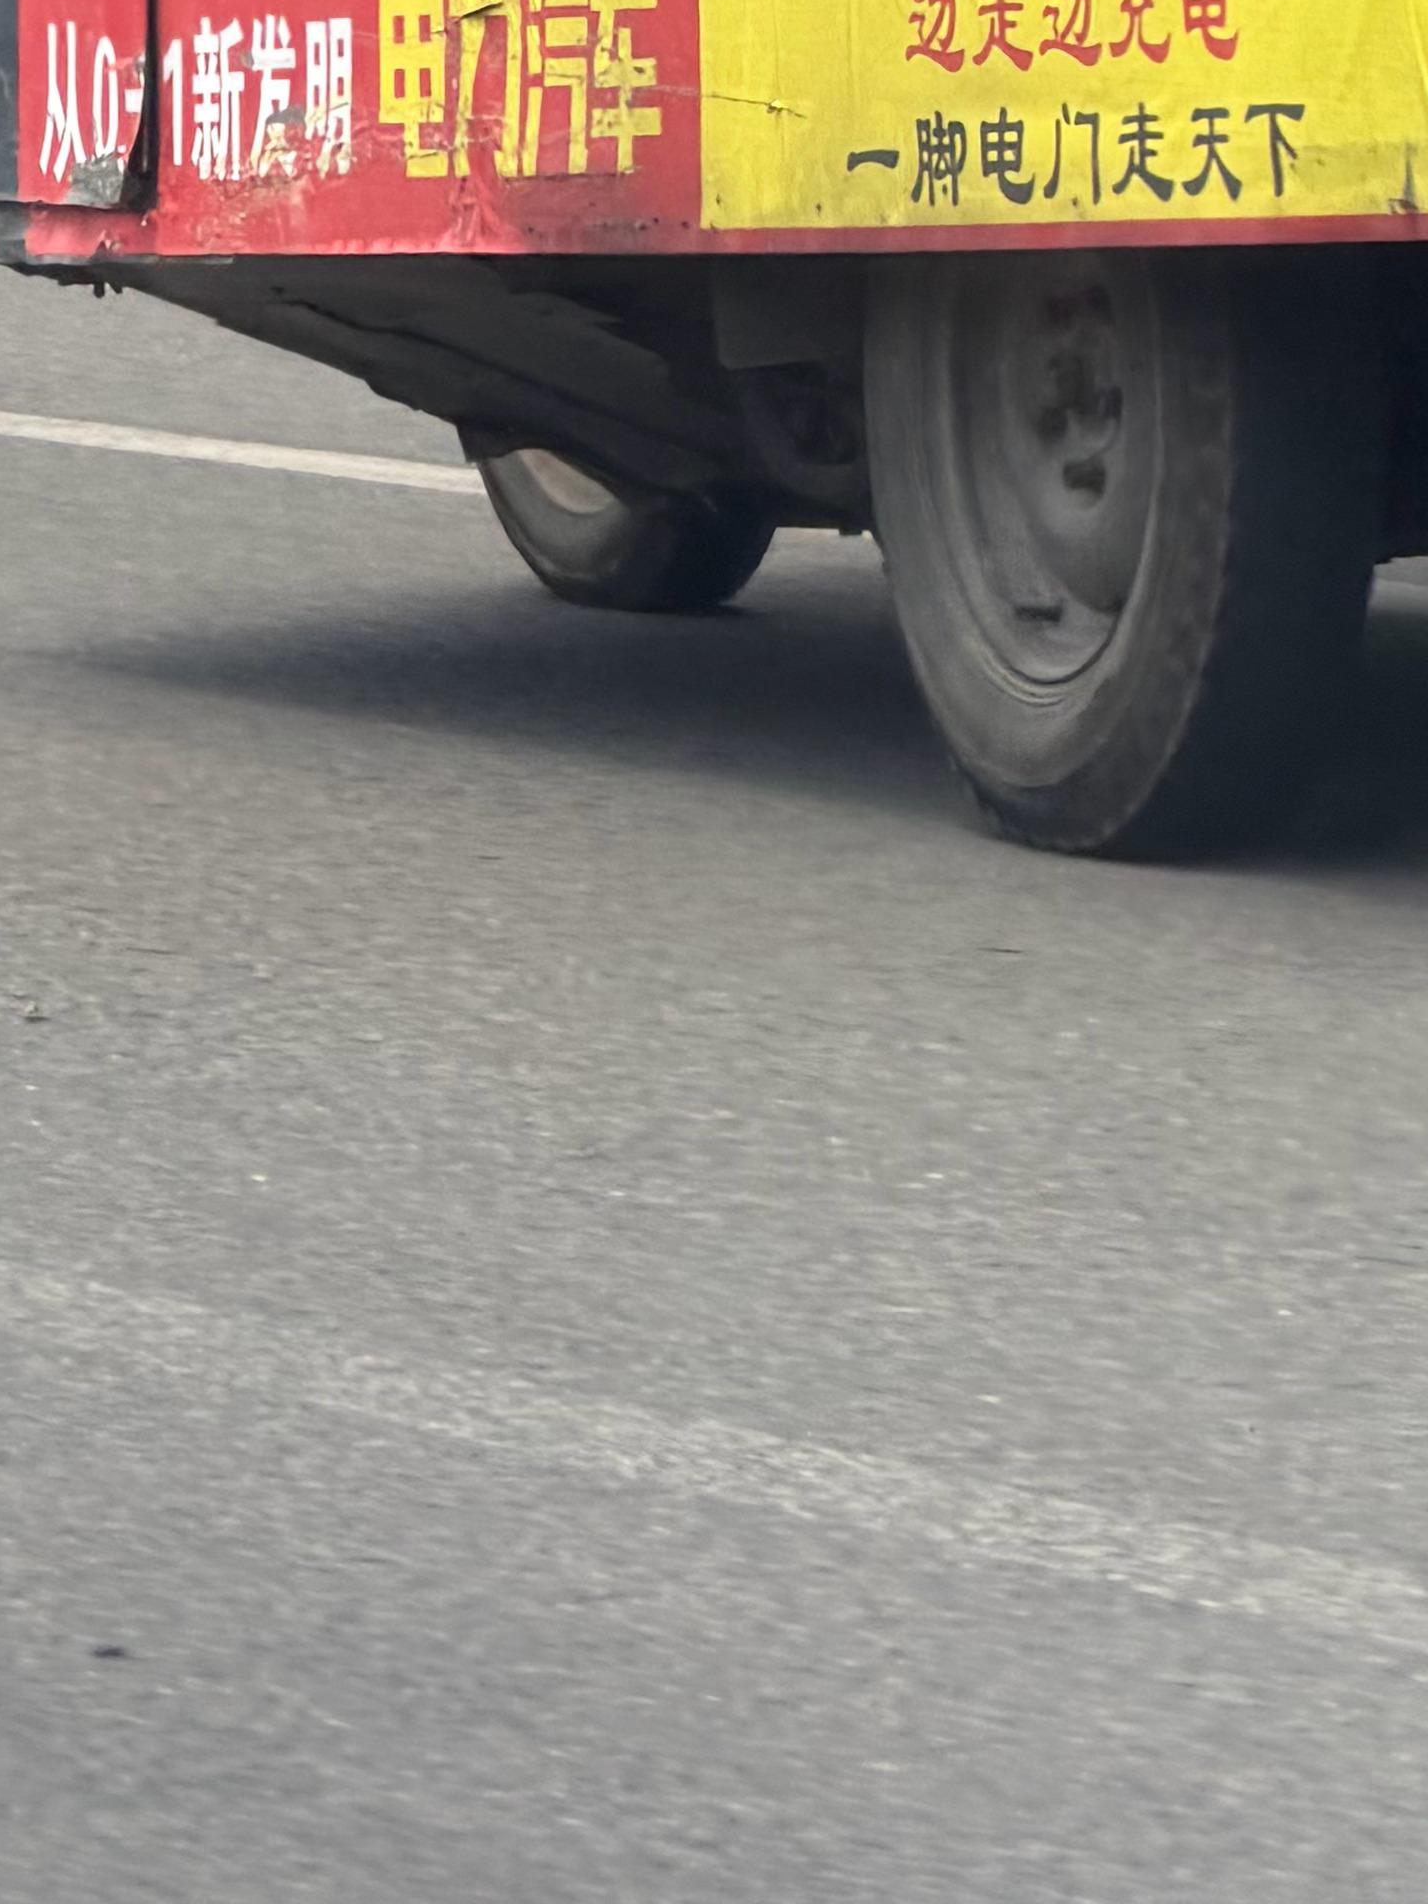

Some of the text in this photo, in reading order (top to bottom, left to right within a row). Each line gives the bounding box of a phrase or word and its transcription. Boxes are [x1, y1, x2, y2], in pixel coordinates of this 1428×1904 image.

[847, 102, 1305, 206] 一脚电门走天下
